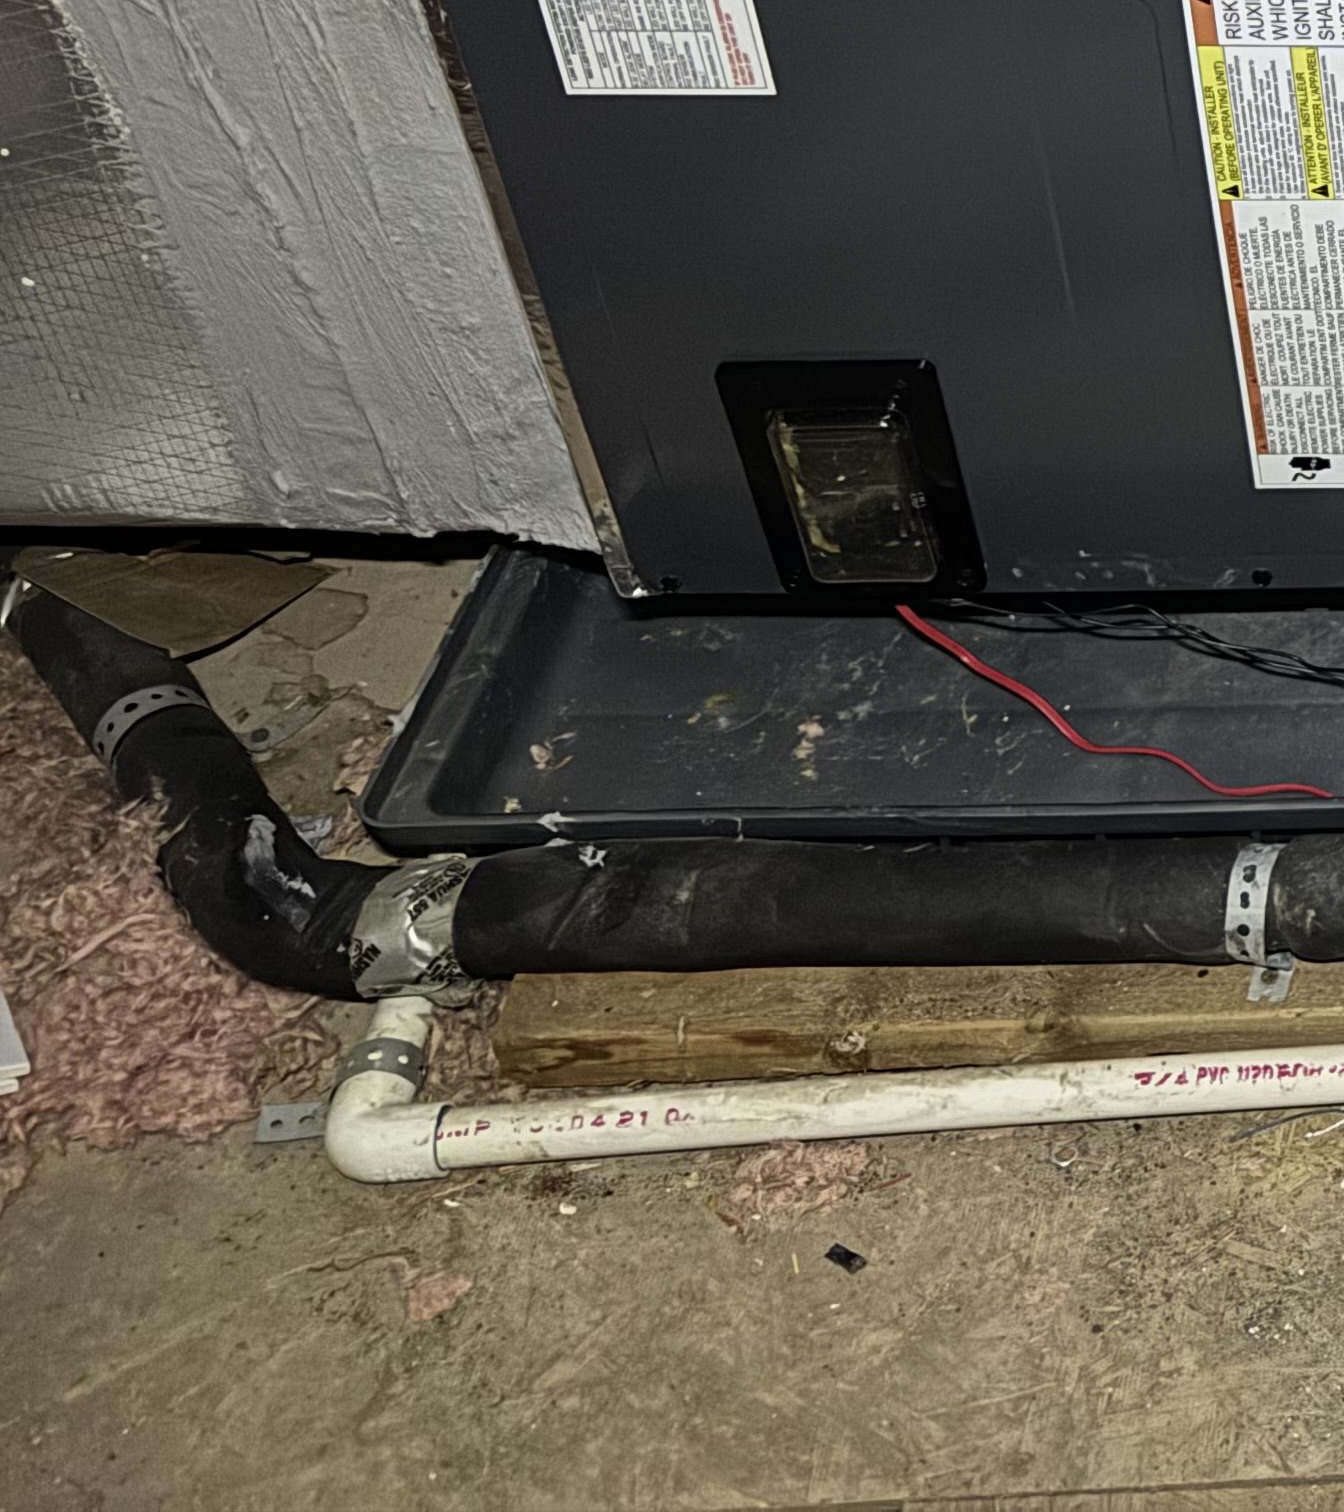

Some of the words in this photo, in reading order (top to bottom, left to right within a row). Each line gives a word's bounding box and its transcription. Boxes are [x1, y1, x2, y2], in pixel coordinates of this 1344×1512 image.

[1220, 0, 1242, 38] RISK
[1212, 60, 1227, 85] UNIT)
[1203, 85, 1220, 134] INSTALLER
[1216, 88, 1234, 140] OPERATING
[1211, 142, 1227, 182] CAUTION
[1224, 143, 1241, 180] (BEFORE
